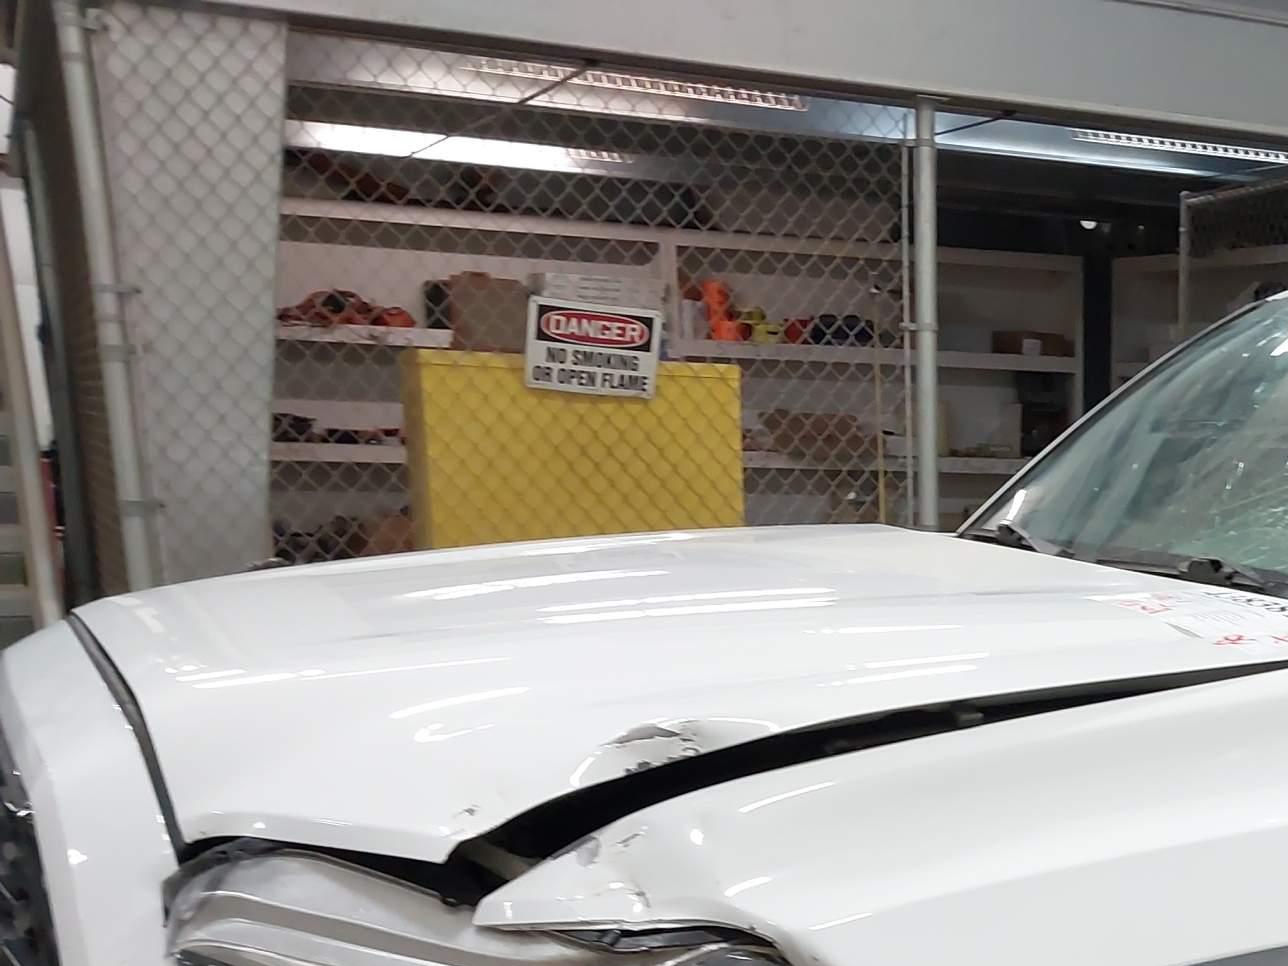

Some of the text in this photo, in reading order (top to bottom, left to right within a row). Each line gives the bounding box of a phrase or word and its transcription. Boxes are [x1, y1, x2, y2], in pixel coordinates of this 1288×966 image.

[550, 315, 642, 343] DANGER
[546, 347, 640, 371] NO SMOKING
[532, 366, 649, 392] OR OPEN FLAME
